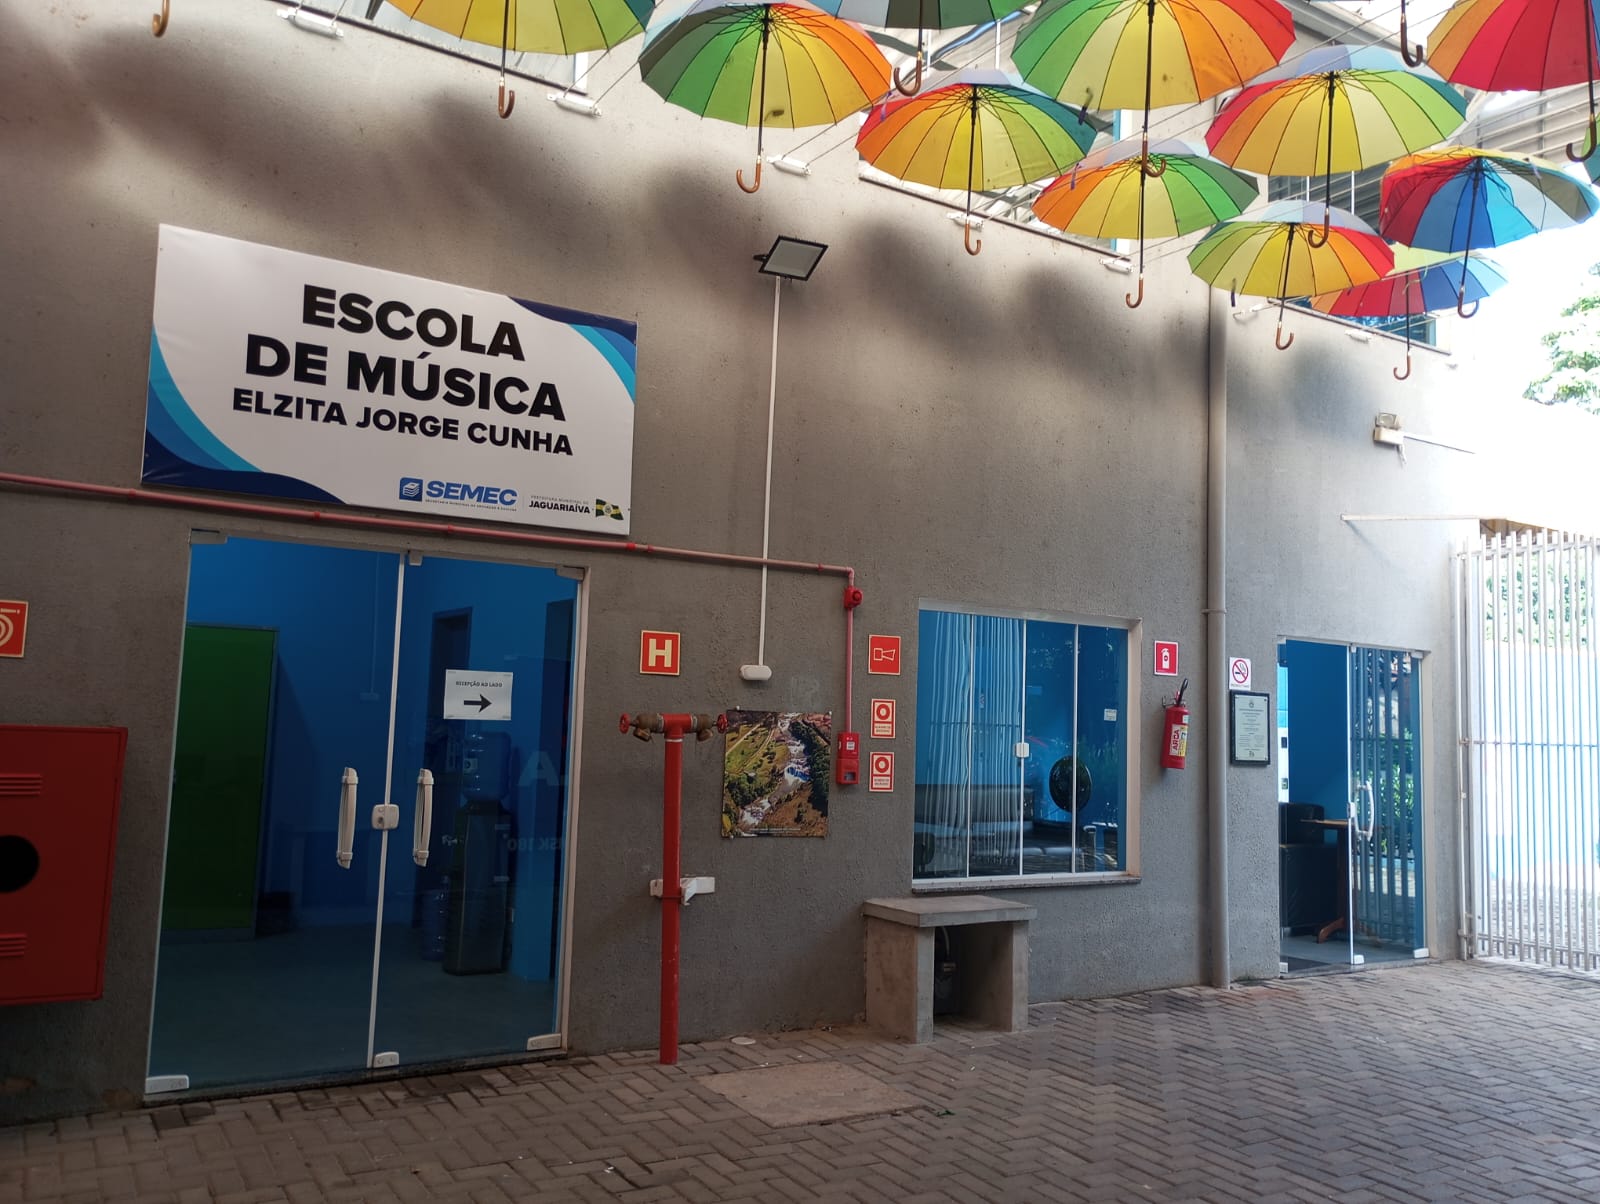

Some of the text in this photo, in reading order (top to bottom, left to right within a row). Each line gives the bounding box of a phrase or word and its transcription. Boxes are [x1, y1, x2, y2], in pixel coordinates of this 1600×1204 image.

[302, 284, 526, 361] ESCOLA
[245, 333, 567, 422] DE MÚSICA
[232, 387, 574, 456] ELZITA JORGE CUNHA
[426, 480, 518, 506] SEMEC
[528, 500, 591, 514] JAGUARIAÍVA
[648, 638, 673, 667] H
